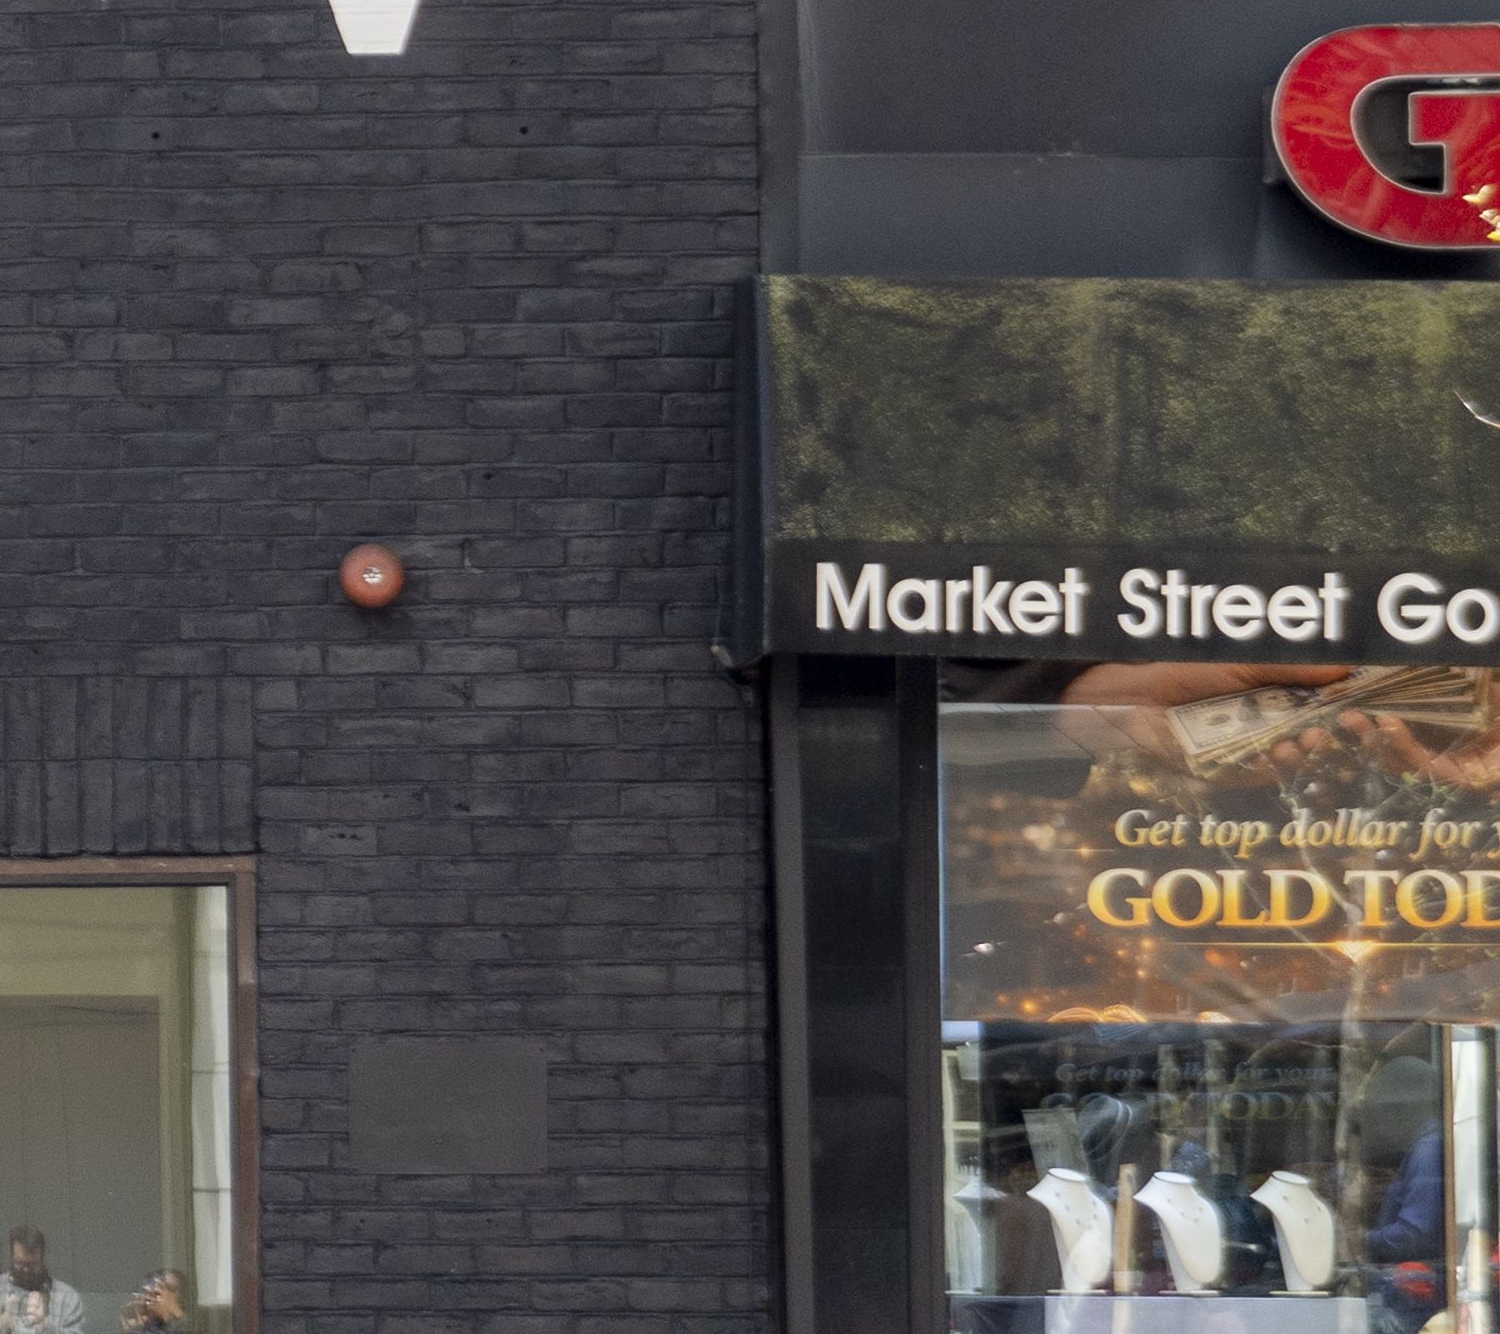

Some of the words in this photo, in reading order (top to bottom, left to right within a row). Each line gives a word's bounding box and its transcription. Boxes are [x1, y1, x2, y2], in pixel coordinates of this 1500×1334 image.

[814, 561, 1090, 637] Market
[1116, 568, 1346, 643] Street
[1376, 573, 1500, 645] Go
[1113, 808, 1188, 848] Get
[1199, 812, 1268, 860] top
[1279, 807, 1408, 849] dollar
[1408, 807, 1481, 861] for
[1086, 867, 1332, 928] GOLD
